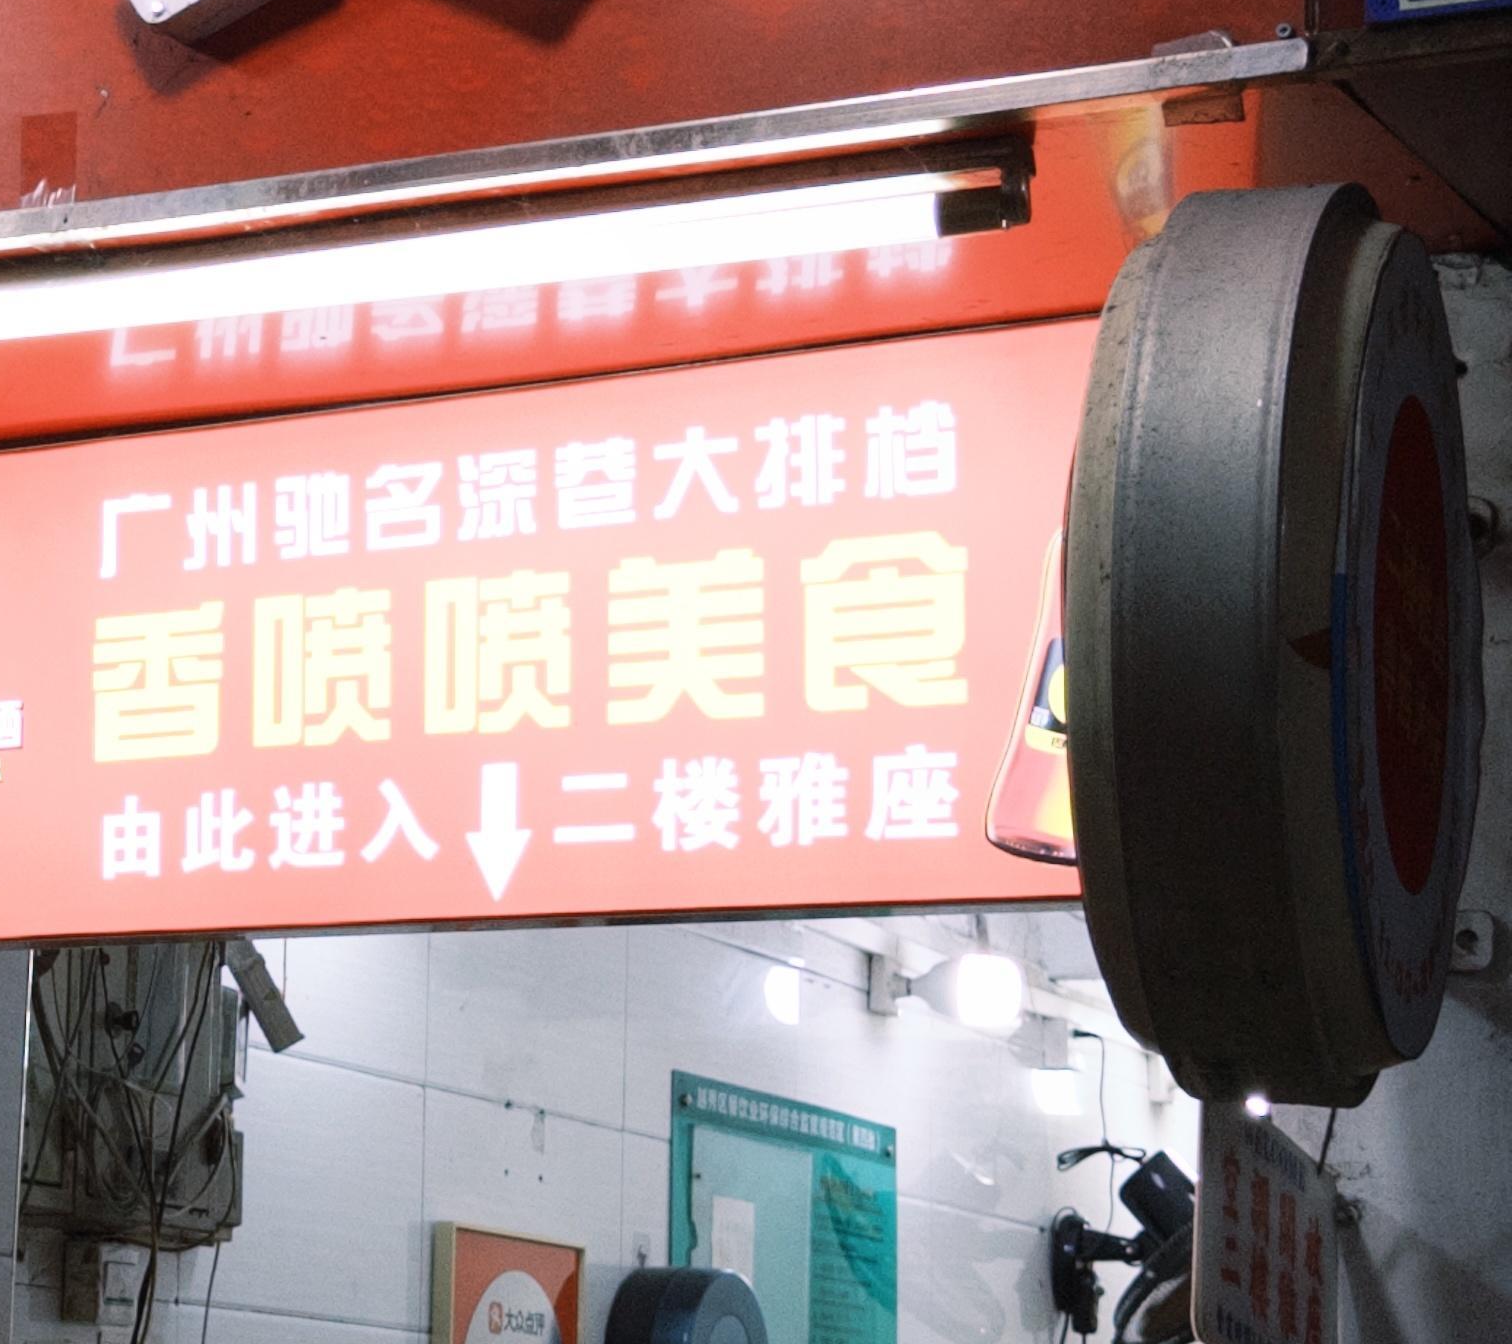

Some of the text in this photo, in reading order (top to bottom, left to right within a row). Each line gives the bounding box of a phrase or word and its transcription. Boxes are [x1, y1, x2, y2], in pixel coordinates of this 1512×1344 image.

[101, 402, 958, 578] 广州驰名深巷大排档
[92, 532, 970, 763] 香喷喷美食
[101, 746, 961, 881] 由此进入 二楼雅座
